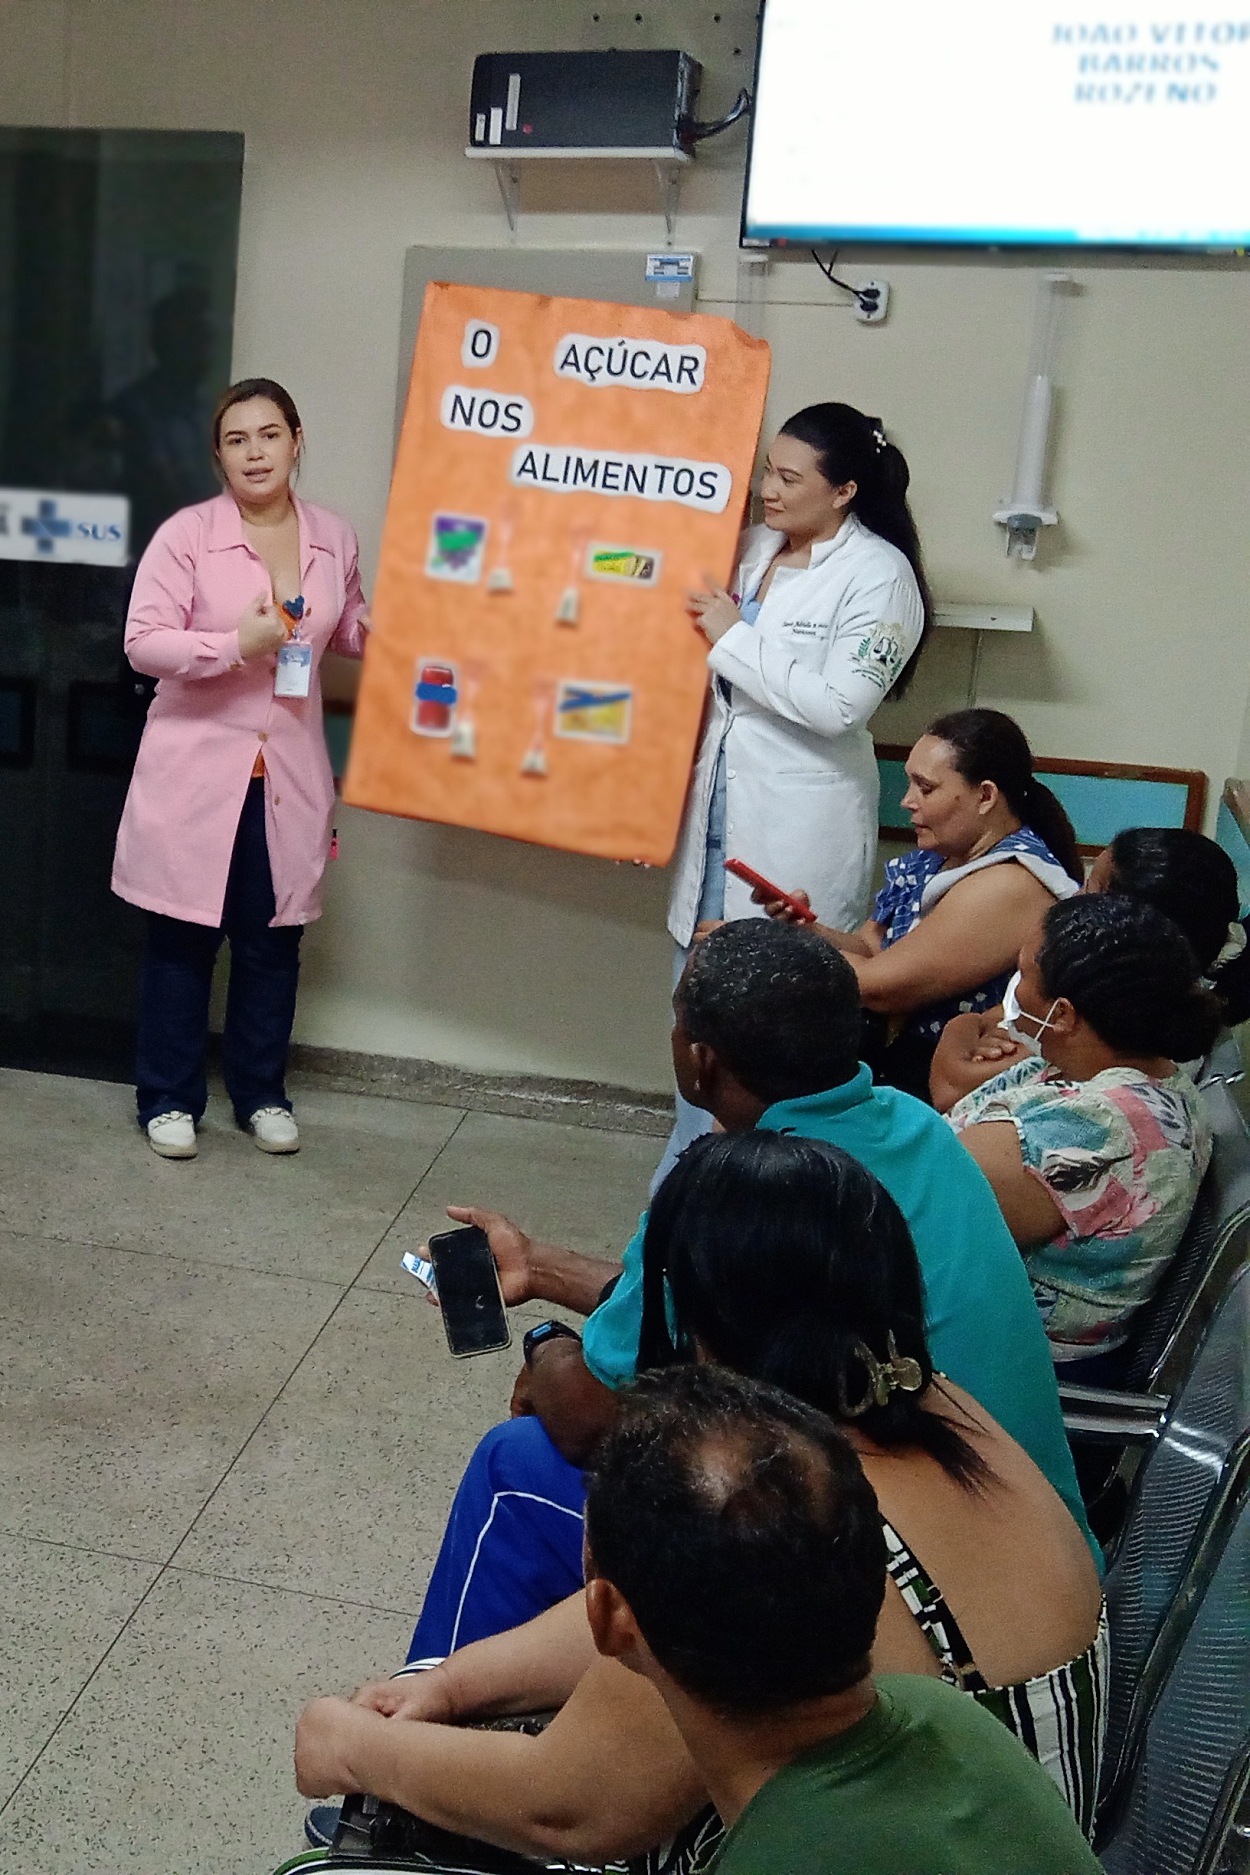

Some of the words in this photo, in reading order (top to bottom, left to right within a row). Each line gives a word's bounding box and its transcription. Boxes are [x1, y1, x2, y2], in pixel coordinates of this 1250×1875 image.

[1079, 52, 1220, 75] BARROS
[470, 327, 492, 359] O
[559, 340, 700, 385] AÇÚCAR
[450, 393, 524, 433] NOS
[516, 449, 718, 500] ALIMENTOS
[77, 521, 123, 542] SUS
